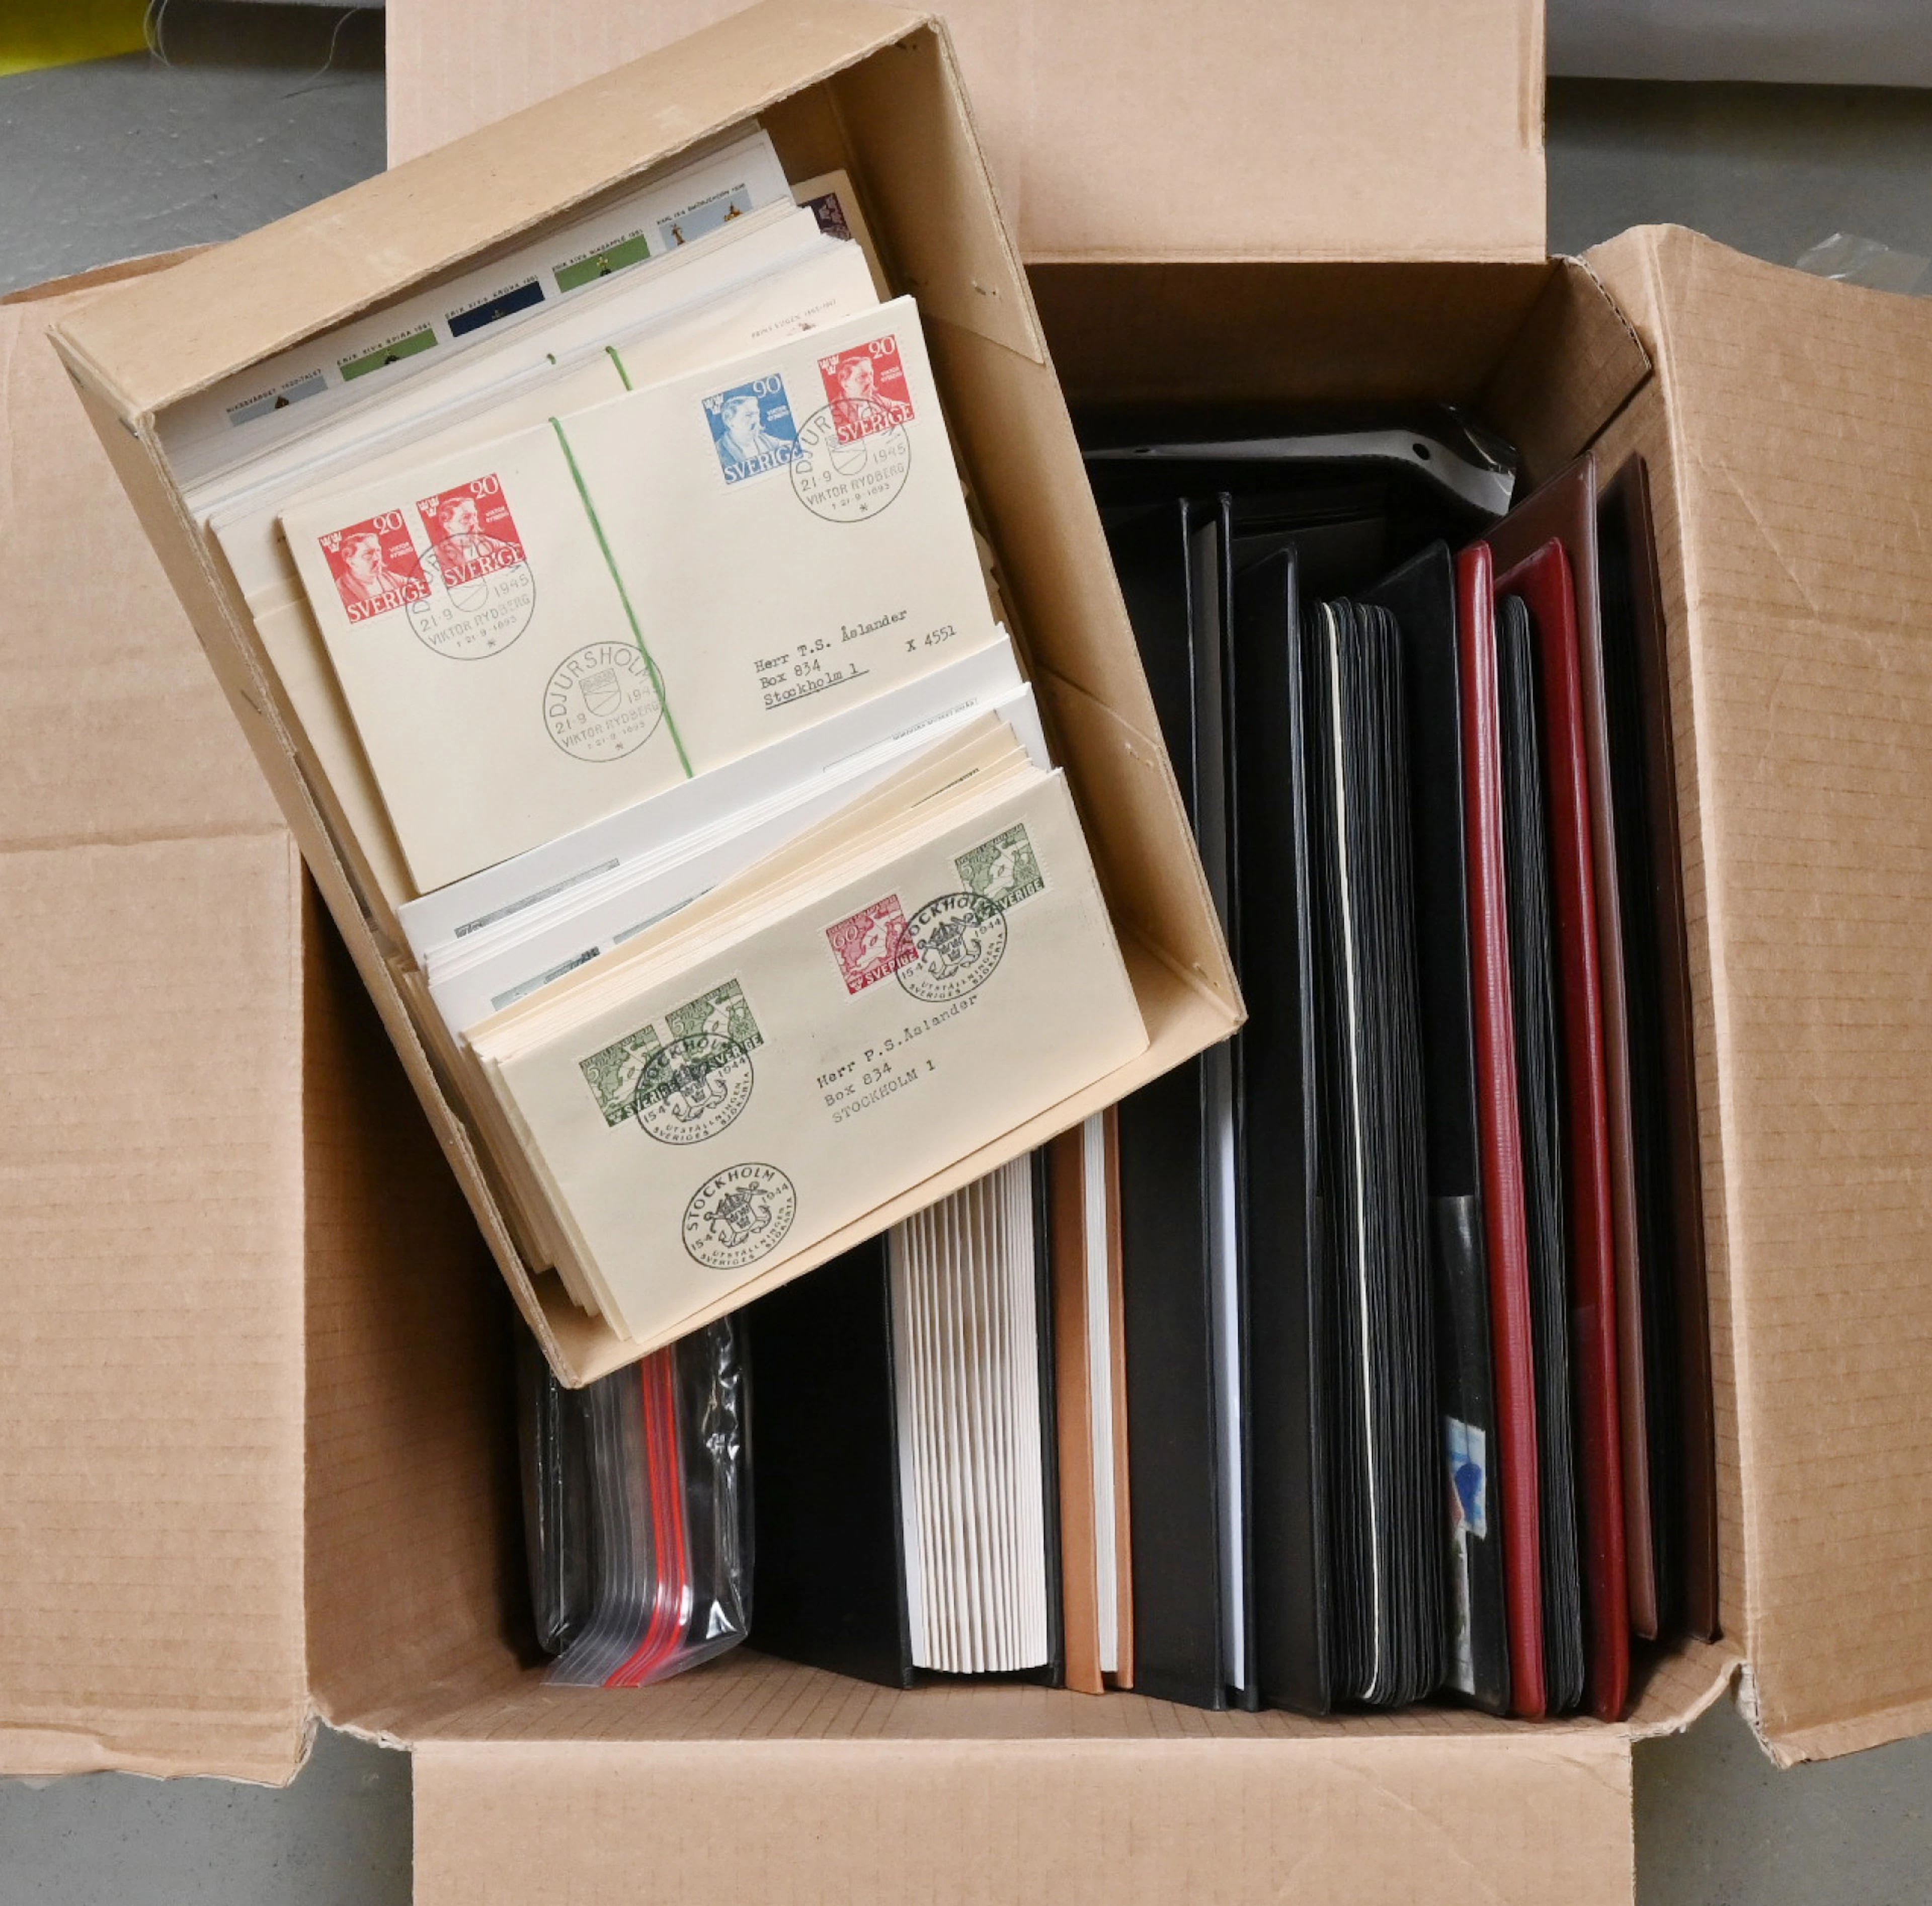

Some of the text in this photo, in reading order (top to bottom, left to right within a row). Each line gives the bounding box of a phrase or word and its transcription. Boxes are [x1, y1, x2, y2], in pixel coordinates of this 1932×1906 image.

[753, 376, 781, 399] 90
[838, 405, 914, 443] SVERIGE
[723, 441, 804, 482] SVERIGE
[807, 462, 904, 505] VIKTOR RYDBERG
[444, 545, 526, 586] SVERIGE
[347, 580, 430, 622] SVERIGE
[428, 620, 472, 646] VIKTOR
[753, 609, 907, 673] Herr T.S. Åslander
[905, 625, 957, 653] X 4551
[760, 659, 821, 690] Box 834
[763, 671, 844, 706] Stockholm
[627, 686, 657, 704] 194
[561, 724, 604, 748] VIKTOR
[833, 926, 857, 948] 60
[707, 1037, 761, 1070] SVERGE
[817, 1061, 856, 1089] Herr
[824, 1062, 893, 1107] Box 834
[832, 1059, 936, 1123] STOCKHOLM 1
[686, 1166, 775, 1231] STOCKHOLM
